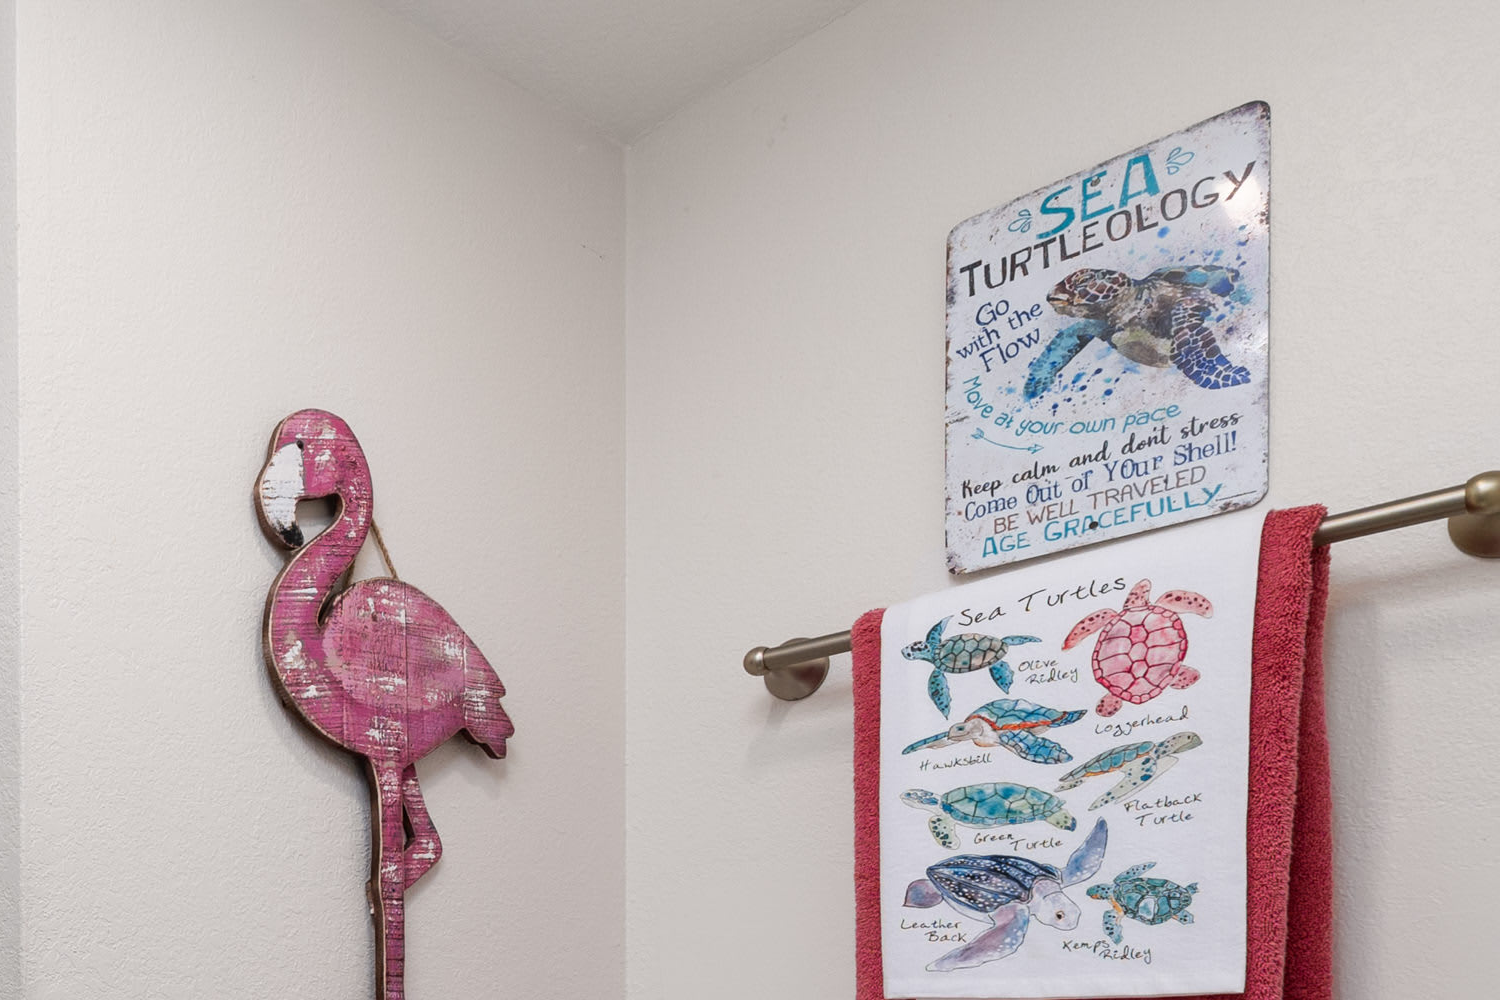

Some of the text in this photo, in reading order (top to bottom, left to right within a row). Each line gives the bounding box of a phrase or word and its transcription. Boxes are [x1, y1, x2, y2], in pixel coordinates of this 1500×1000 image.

[1036, 153, 1160, 239] SEA
[959, 160, 1257, 298] TURTLEOLOGY
[956, 304, 1043, 359] with the
[979, 328, 1040, 373] Flow
[963, 375, 1182, 437] Move at your own pace
[962, 478, 1003, 499] Keep
[1012, 461, 1060, 484] calm
[1069, 440, 1112, 468] and
[1180, 413, 1243, 440] stress
[965, 496, 1017, 522] Come
[1027, 481, 1062, 505] Out
[1071, 469, 1094, 493] of
[1173, 430, 1237, 467] Shell!
[994, 465, 1206, 534] BE WELL TRAVELED
[983, 483, 1223, 558] AGE GRACEFULLY
[958, 577, 1127, 627] Sea Turtles
[1018, 660, 1059, 672] Olive
[1025, 667, 1078, 684] Ridley
[1095, 705, 1188, 737] Loggerhead
[1135, 810, 1194, 826] Turtle
[974, 832, 1014, 844] Green
[1010, 837, 1063, 851] Turtle
[900, 919, 962, 930] Leather
[924, 930, 967, 943] Back
[1062, 940, 1110, 953] Kemps
[1099, 945, 1151, 964] Ridley
